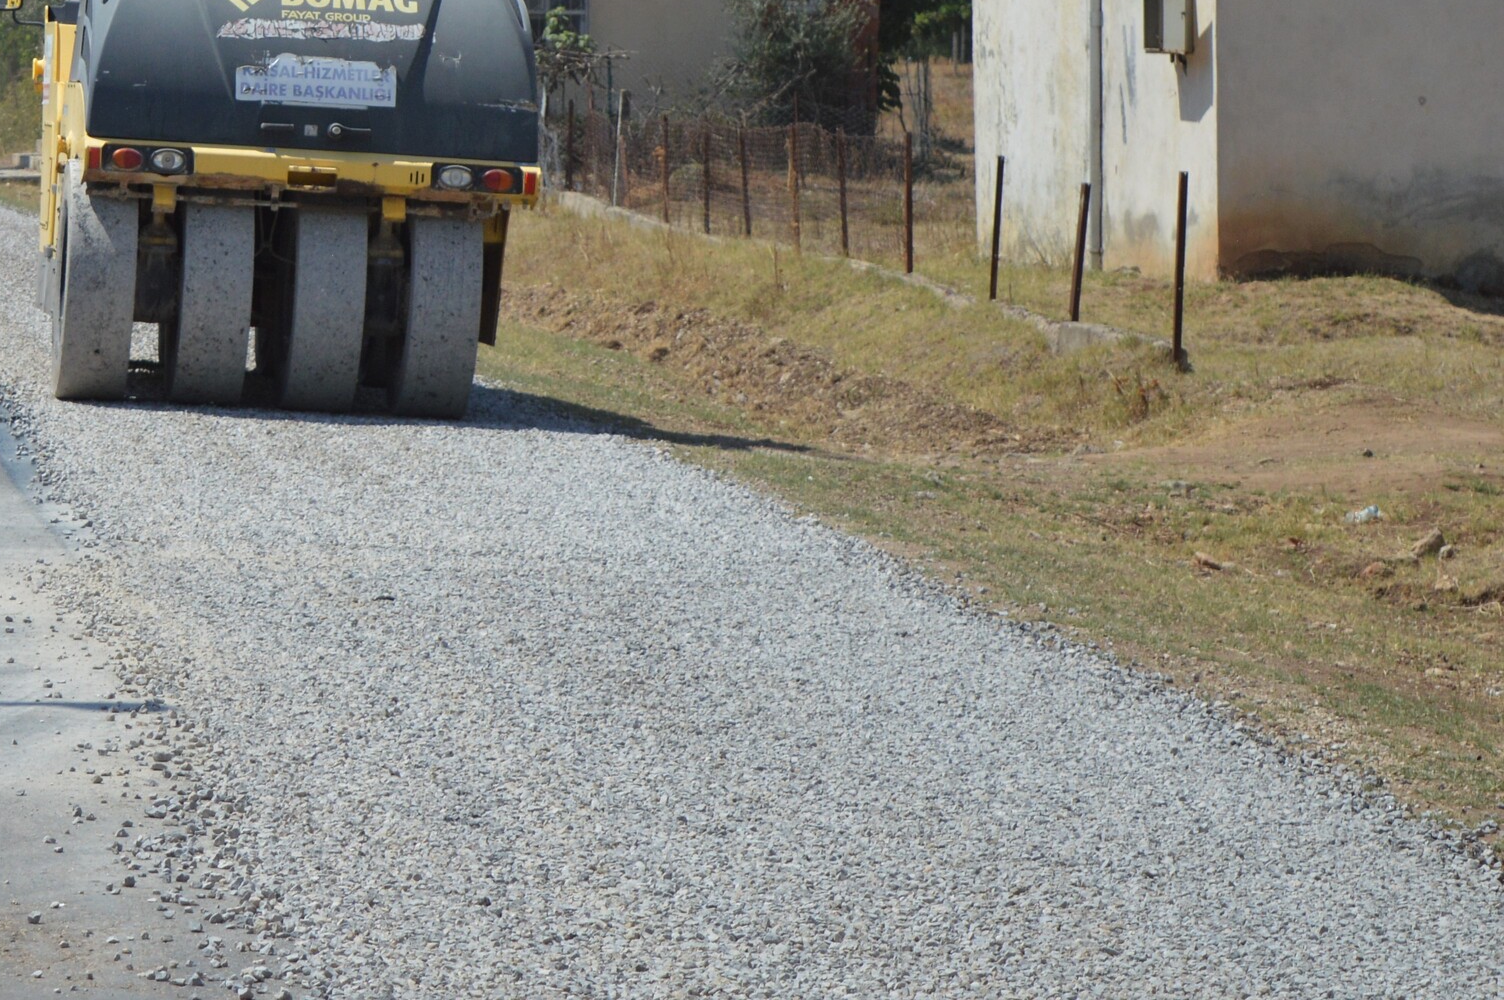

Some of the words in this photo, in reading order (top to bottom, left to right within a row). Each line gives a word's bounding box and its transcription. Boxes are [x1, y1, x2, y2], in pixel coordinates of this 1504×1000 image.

[281, 9, 321, 21] FAYAT
[325, 11, 371, 23] GROUP
[240, 78, 288, 97] DAİRE
[293, 83, 392, 102] BAŞKANLIĞI
